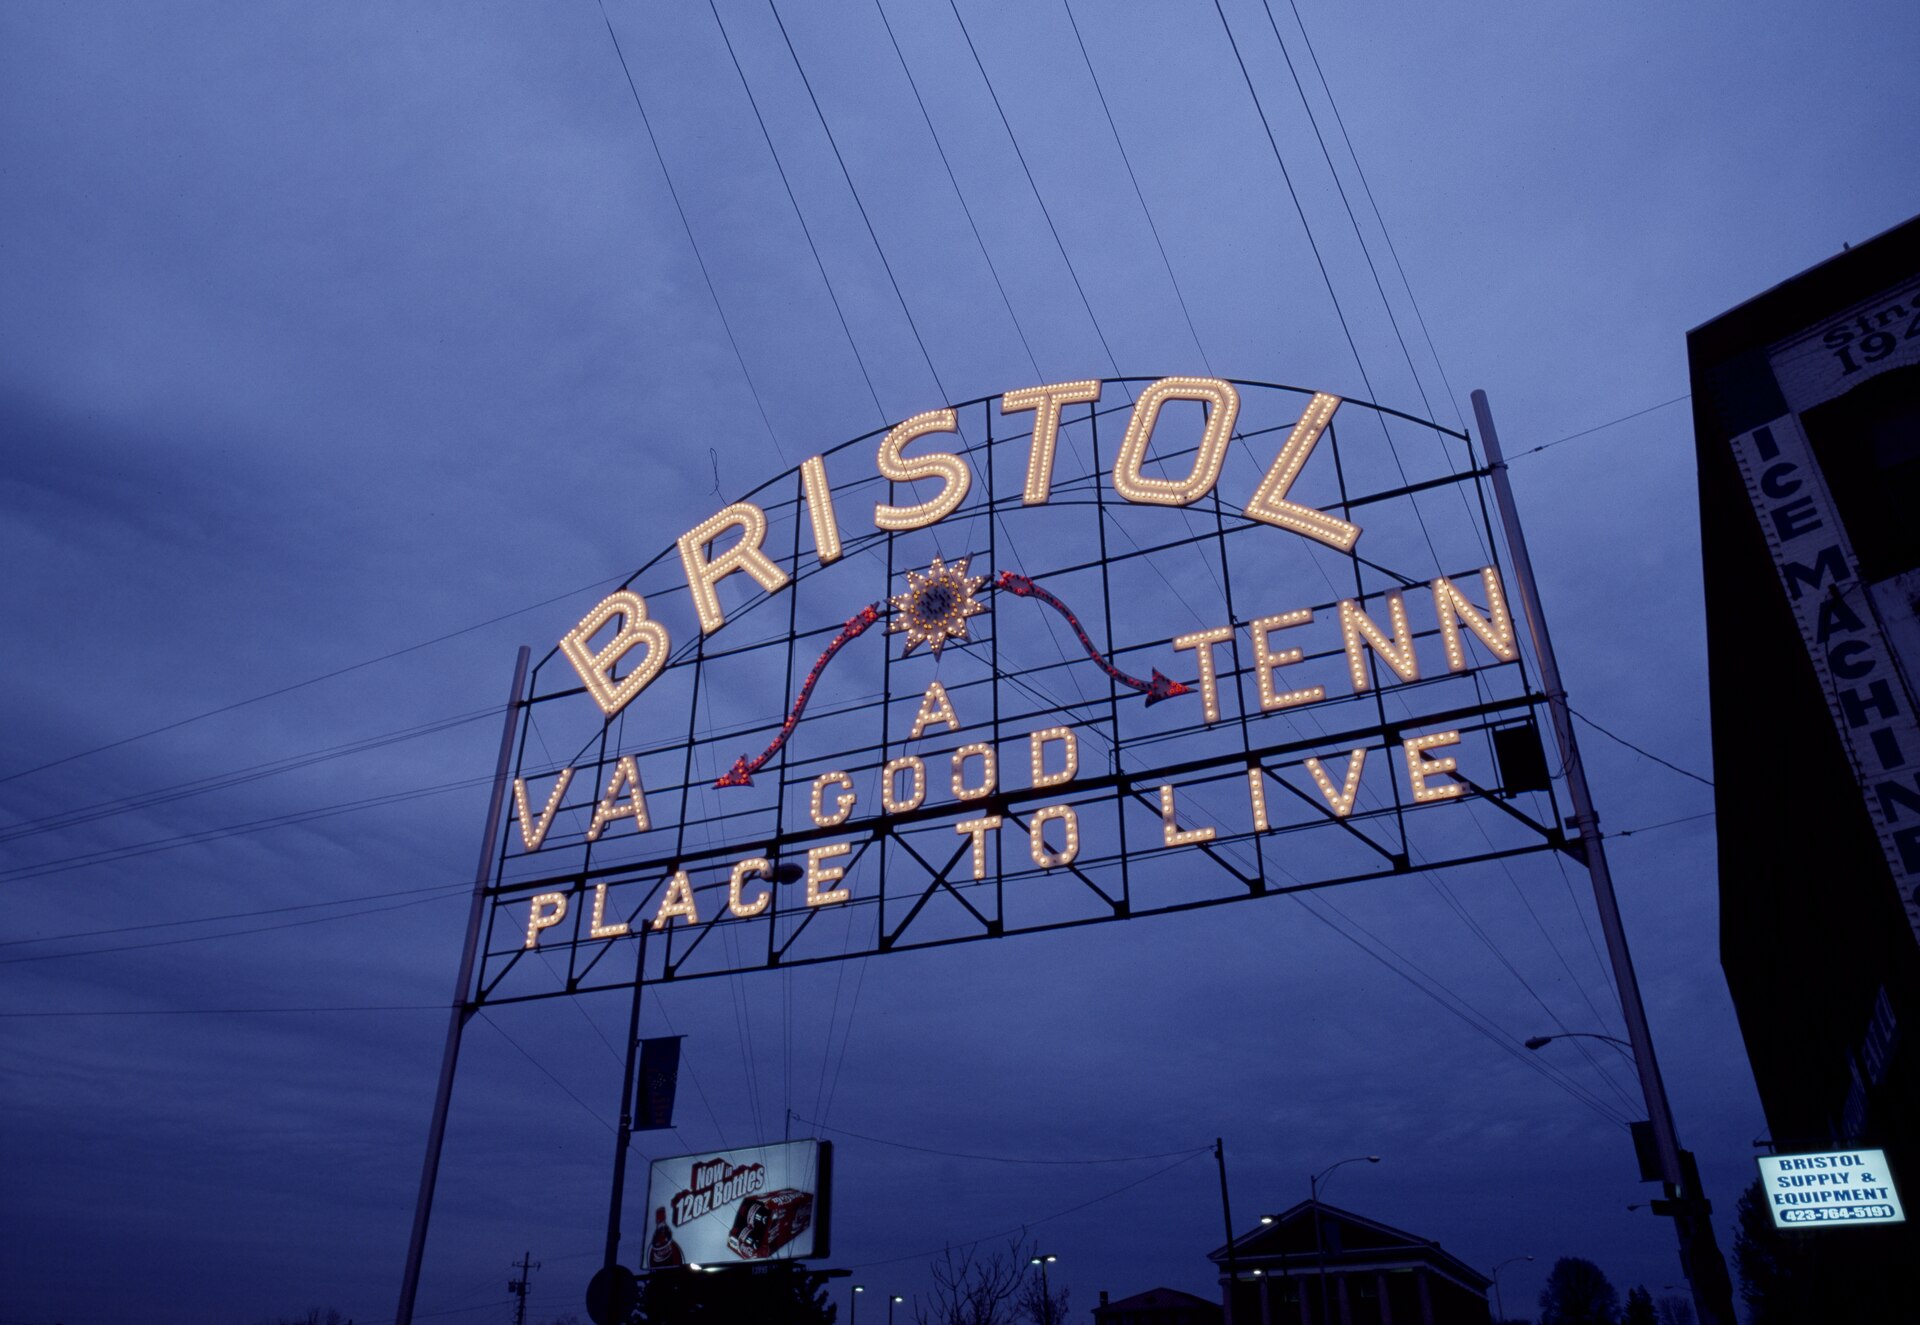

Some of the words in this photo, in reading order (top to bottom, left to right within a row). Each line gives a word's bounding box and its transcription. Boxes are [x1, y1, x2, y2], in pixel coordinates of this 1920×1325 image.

[1752, 426, 1823, 542] ICE
[559, 377, 1362, 716] BRISTOL
[1172, 564, 1522, 725] TENN
[911, 681, 960, 739] A
[513, 755, 652, 852] VA
[810, 726, 1078, 828] GOOD
[525, 843, 852, 949] PLACE
[956, 804, 1080, 880] TO
[1160, 730, 1470, 847] LIVE
[695, 1161, 725, 1191] Now
[1777, 1172, 1850, 1188] SUPPLY
[1861, 1172, 1877, 1183] &
[1779, 1154, 1865, 1171] BRISTOL
[675, 1190, 713, 1227] 12oz
[713, 1167, 765, 1209] Bottles
[1774, 1187, 1889, 1205] EQUIPMENT
[1786, 1205, 1892, 1221] 423-764-5191
